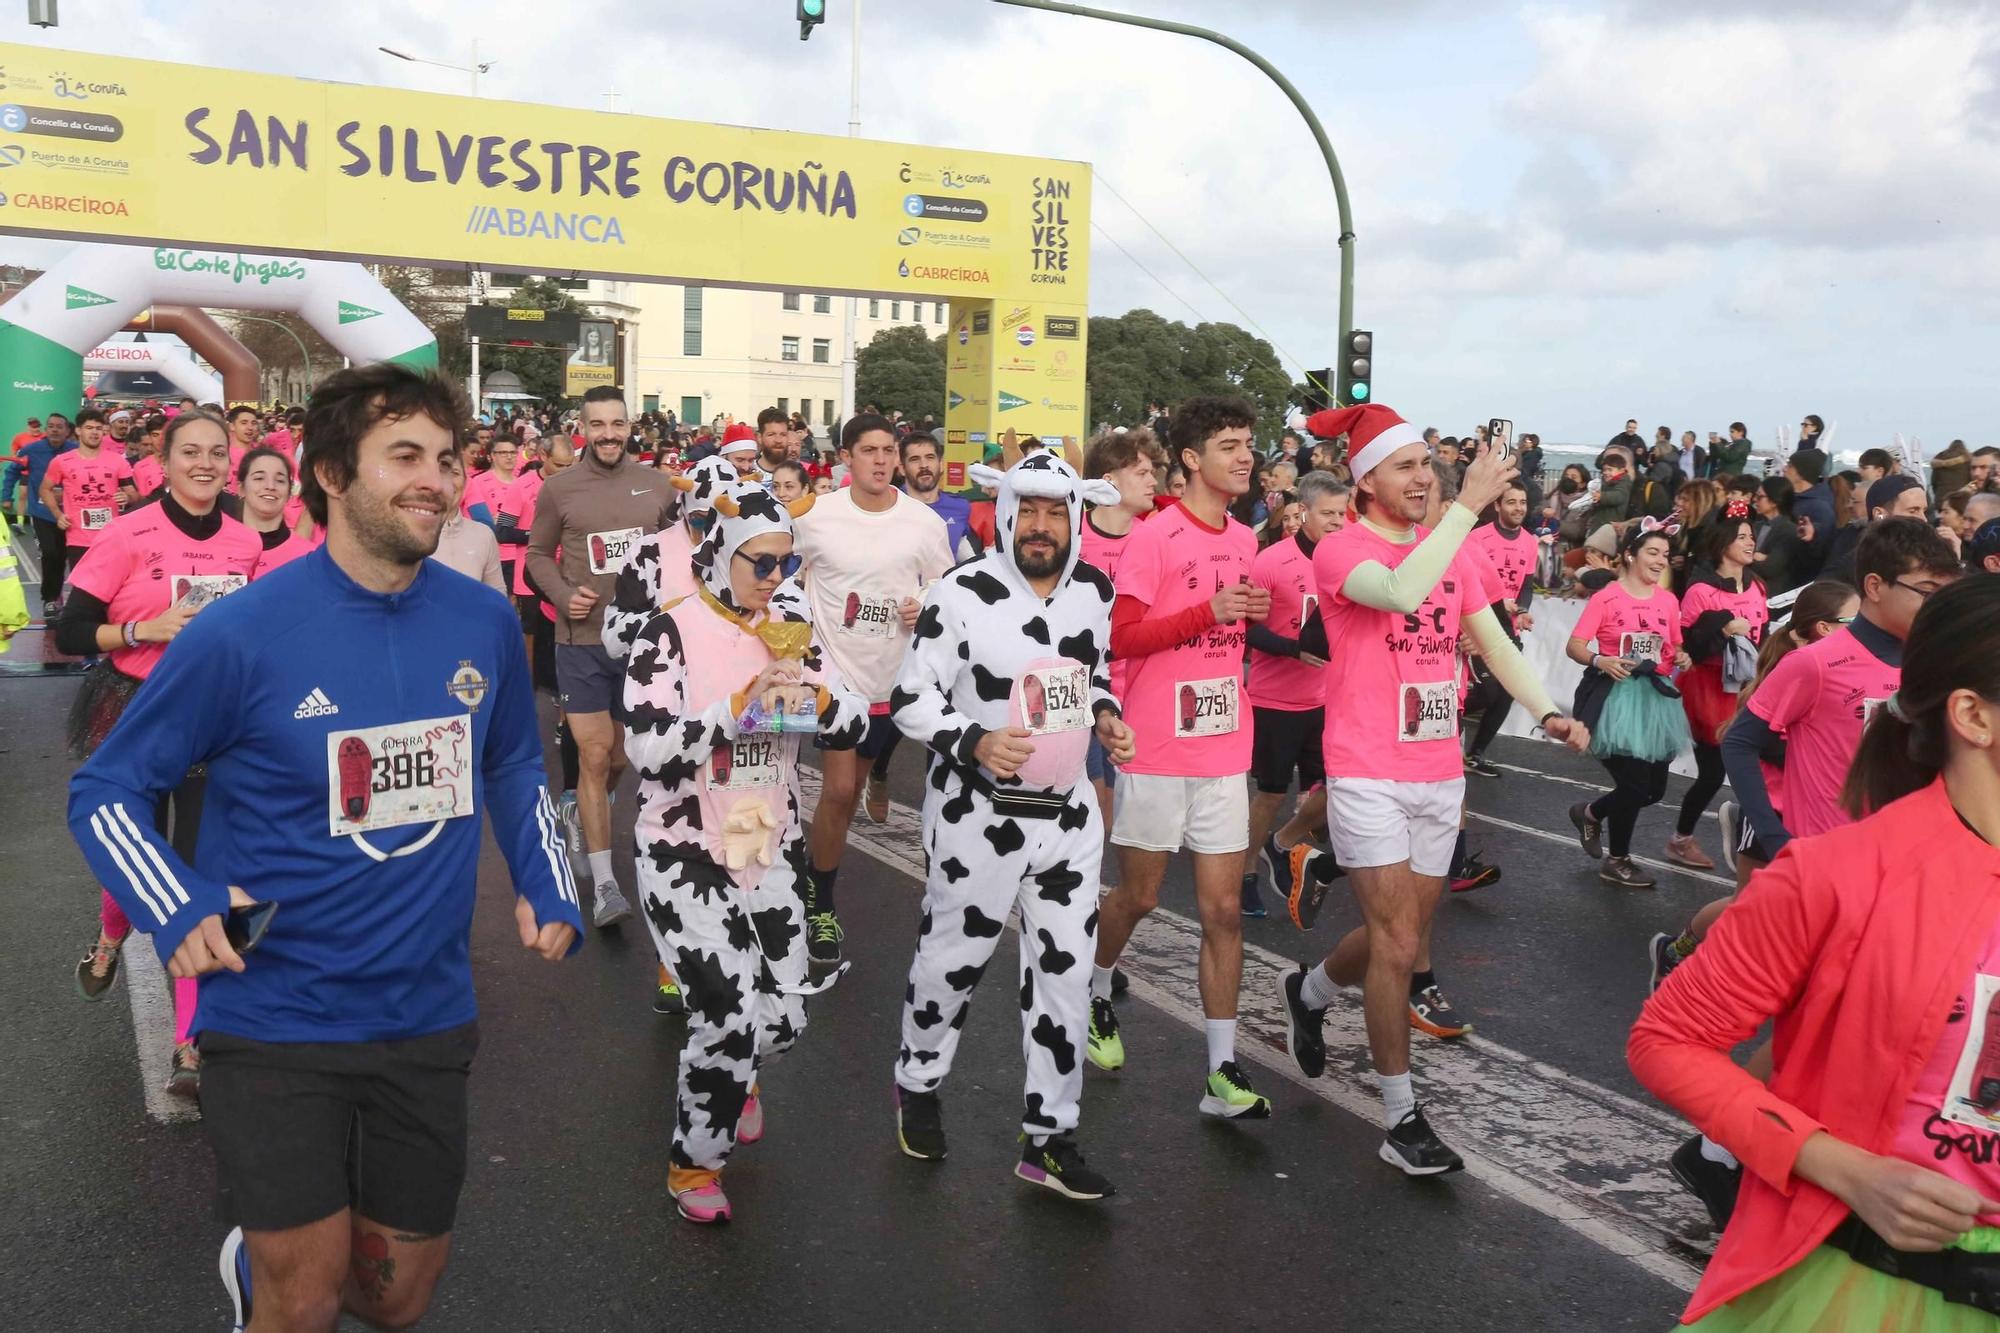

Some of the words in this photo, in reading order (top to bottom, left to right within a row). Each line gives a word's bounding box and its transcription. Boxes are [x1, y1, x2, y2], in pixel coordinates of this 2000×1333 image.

[30, 117, 69, 128] Concello
[70, 121, 82, 129] da
[83, 123, 115, 133] Coruña
[31, 151, 66, 162] Puerto
[70, 155, 81, 163] de
[93, 158, 129, 168] Coruña
[185, 107, 308, 171] SAN
[336, 121, 641, 198] SILVESTRE
[663, 156, 857, 219] CORUÑA
[1032, 177, 1070, 199] SAN
[1032, 200, 1070, 225] SIL
[1031, 225, 1069, 249] VES
[154, 247, 176, 270] El
[179, 250, 230, 275] Corte
[233, 253, 305, 285] Inglés
[1030, 248, 1069, 272] TRE
[294, 703, 339, 719] adidas
[381, 735, 424, 750] GUERRA
[372, 749, 434, 793] 396
